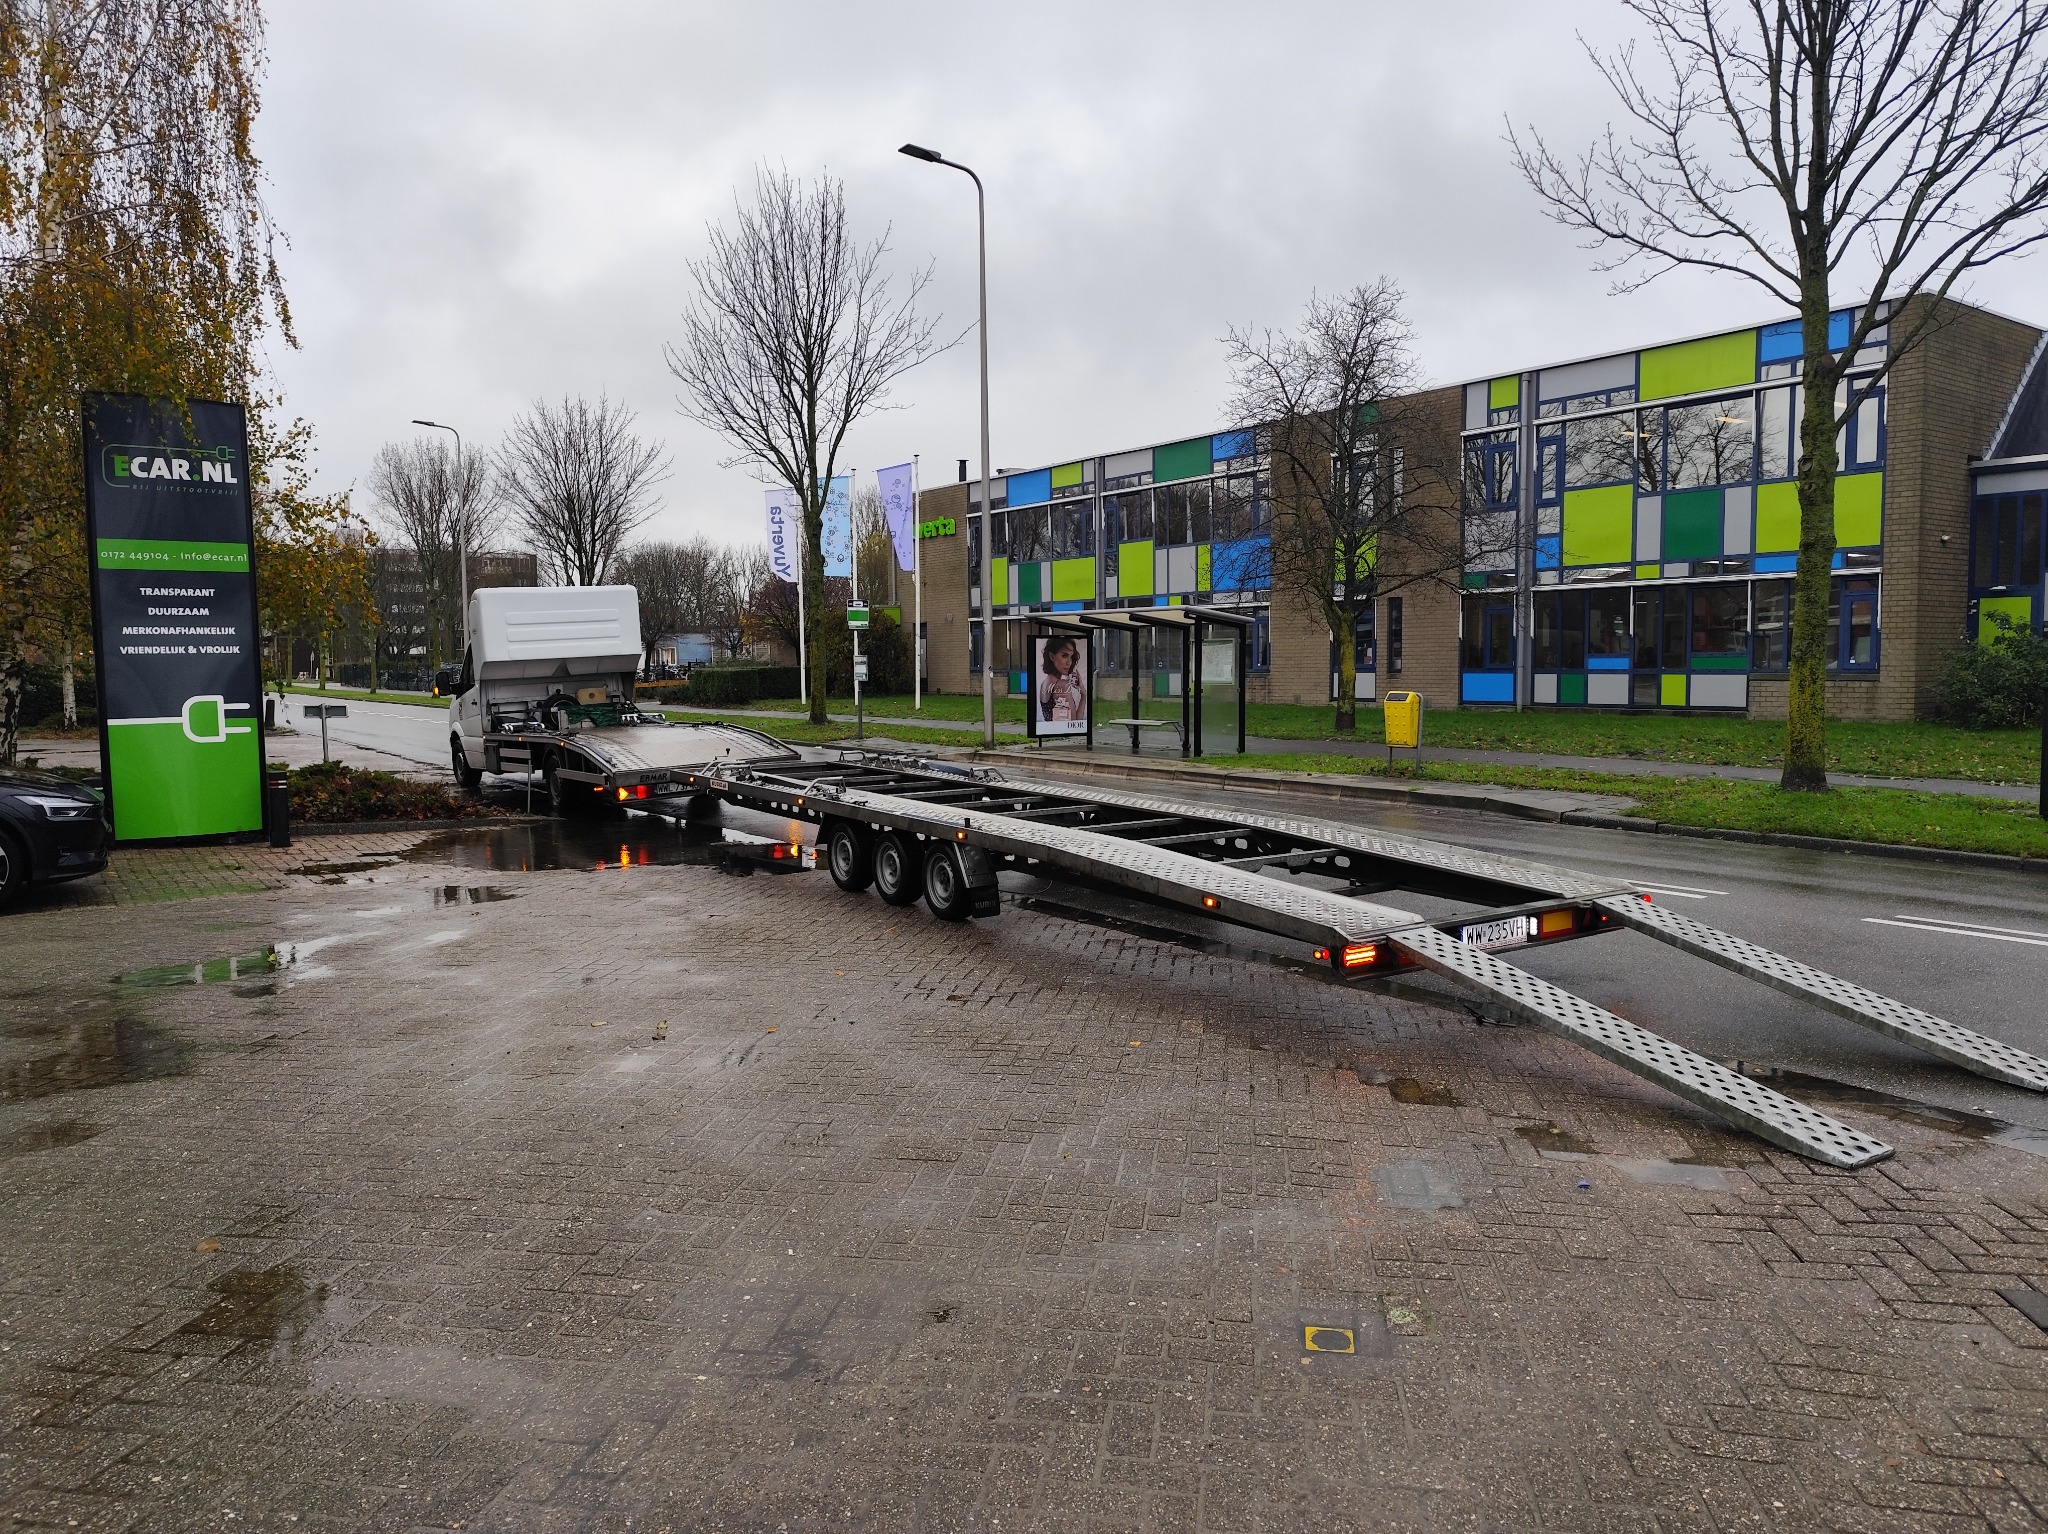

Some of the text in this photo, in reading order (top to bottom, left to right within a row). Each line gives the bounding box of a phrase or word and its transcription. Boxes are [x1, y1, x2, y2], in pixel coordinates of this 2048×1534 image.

[113, 455, 238, 484] ECAR.NL
[100, 551, 126, 559] 0172
[129, 551, 169, 561] 449104
[180, 552, 248, 562] info@ecar.nl
[139, 587, 216, 597] TRANSPARANT
[147, 607, 210, 616] DUURZAAM
[122, 627, 236, 635] MERKONAFHANKELIJK
[119, 646, 241, 655] VRIENDELIJK & VROLIJK
[1466, 926, 1482, 945] WW
[1487, 919, 1524, 942] 235VH
